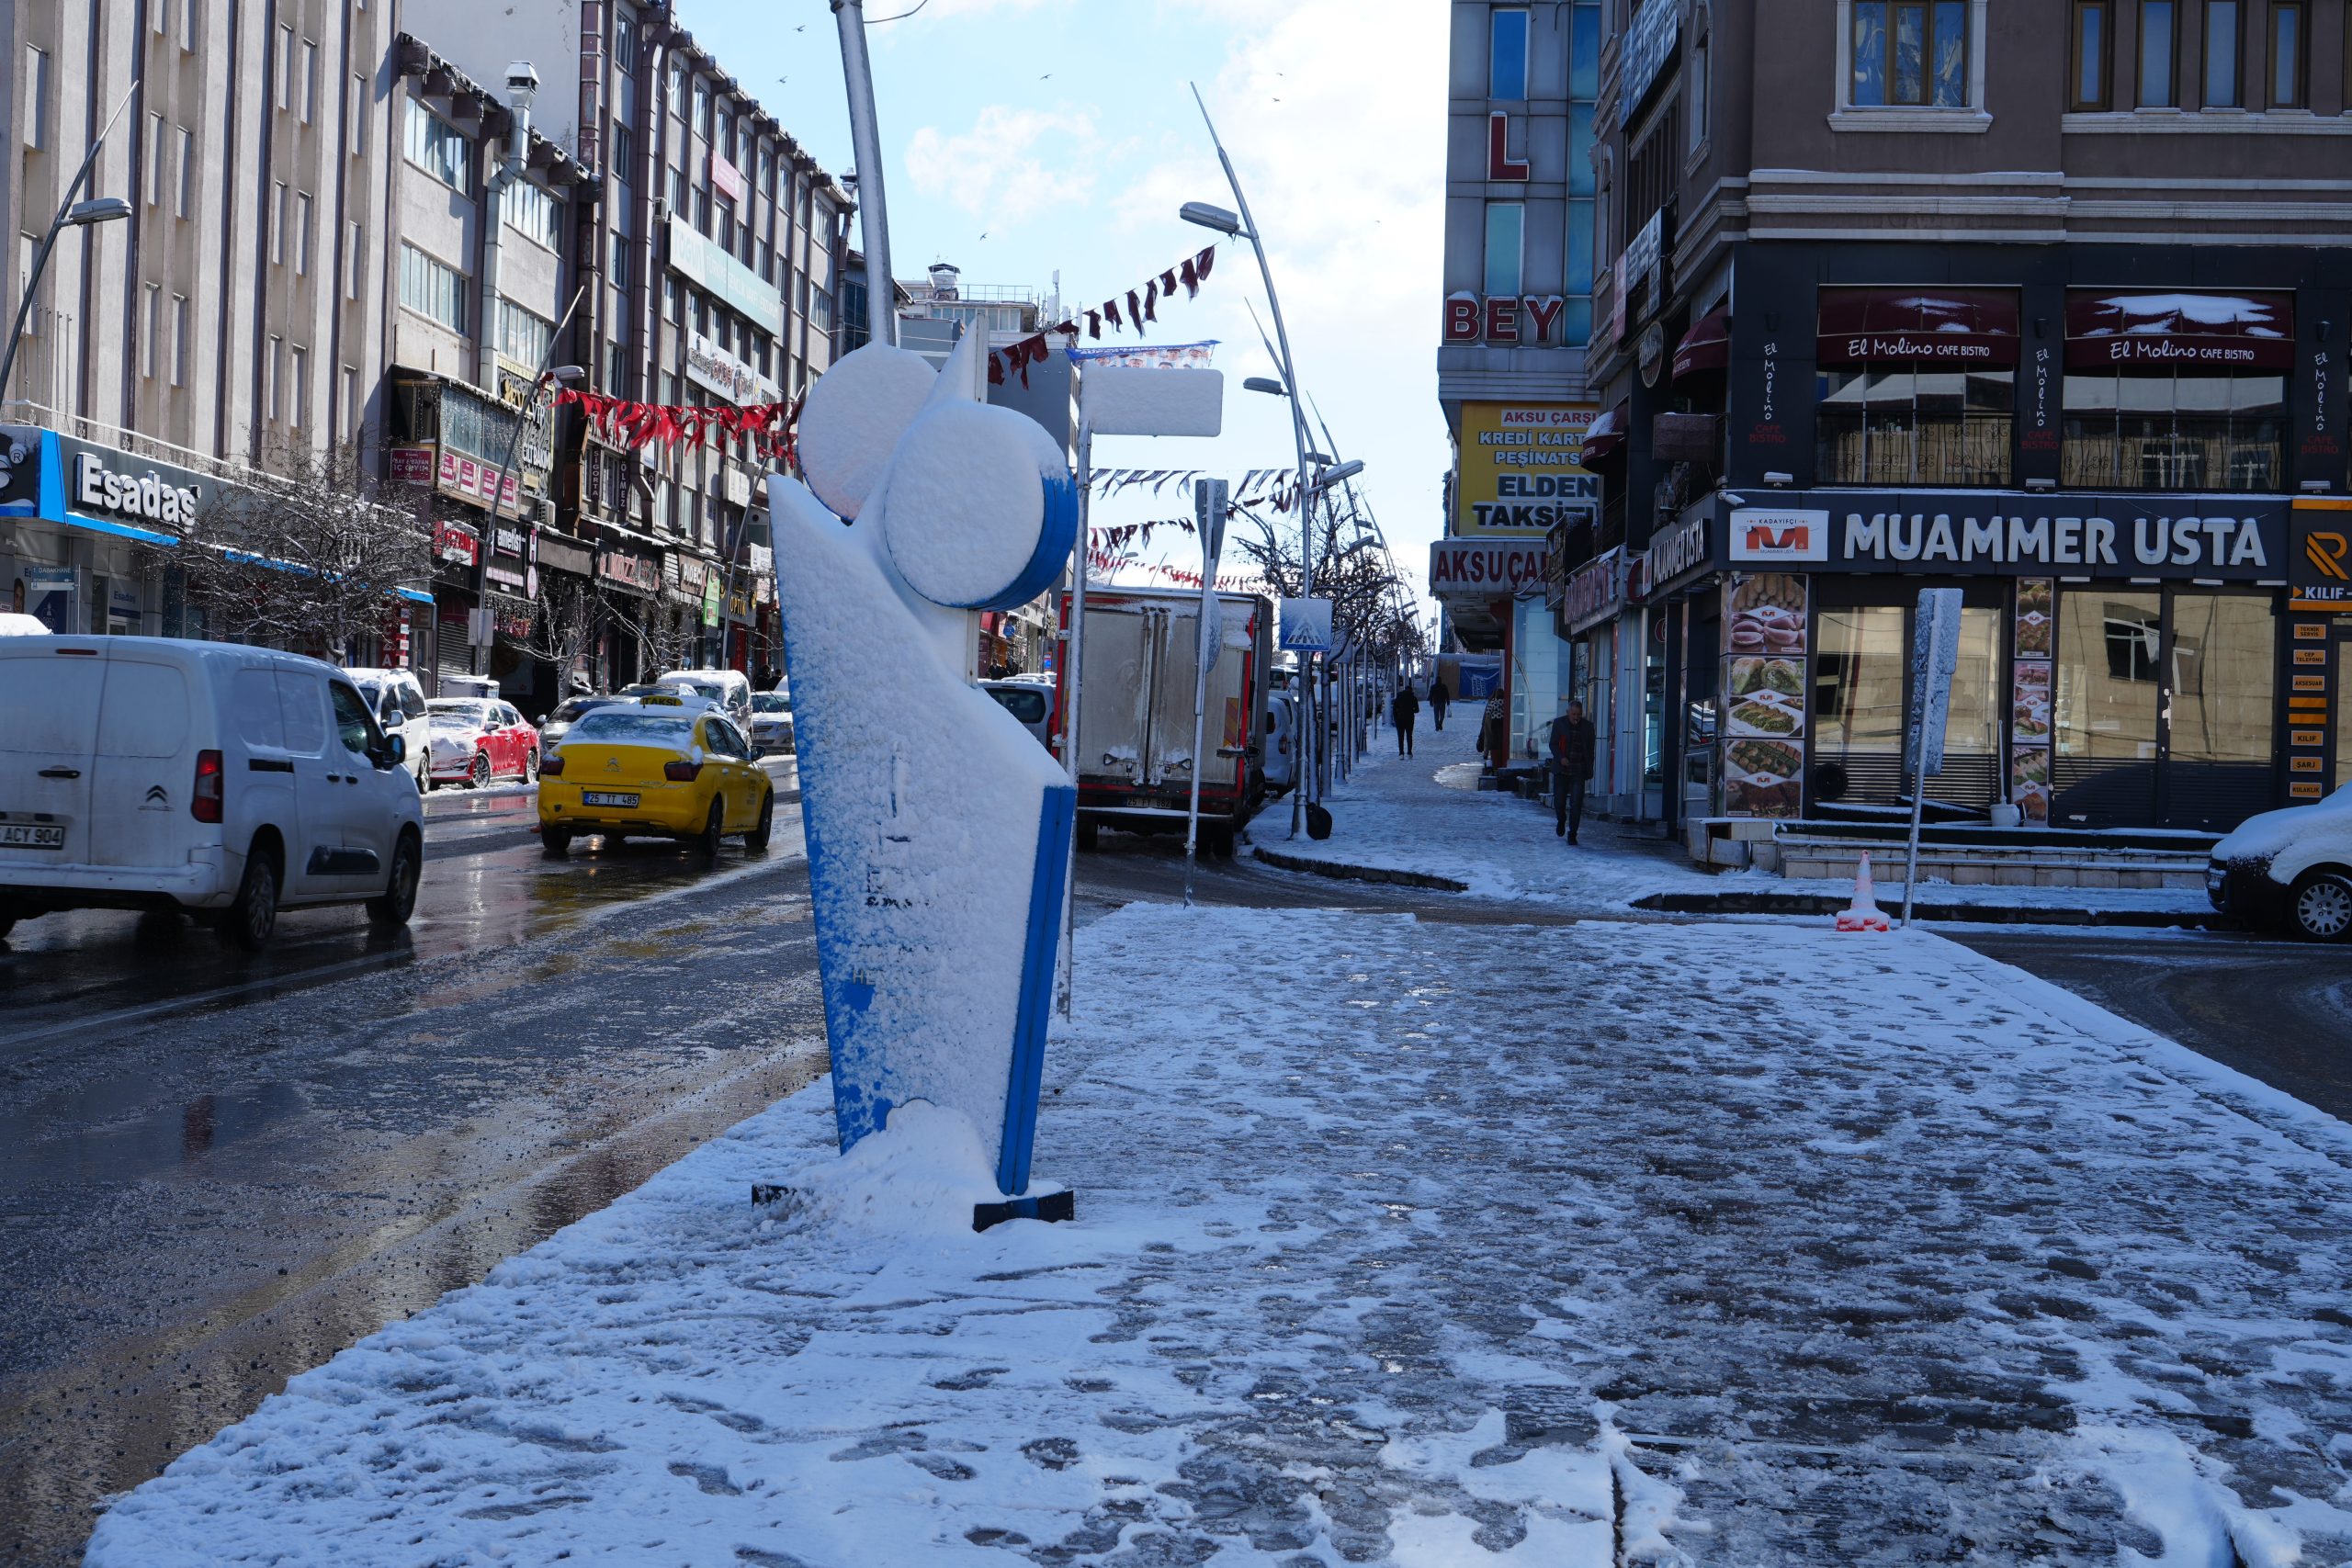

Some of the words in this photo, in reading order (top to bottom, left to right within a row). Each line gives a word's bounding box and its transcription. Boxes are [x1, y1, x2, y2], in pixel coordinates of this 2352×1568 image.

[1444, 297, 1563, 342] BEY
[1764, 343, 1777, 356] El
[1849, 339, 1868, 357] El
[1873, 337, 1933, 355] Molino
[1937, 344, 1959, 355] CAFE
[1962, 345, 1990, 357] BISTRO
[2110, 340, 2131, 359] El
[2136, 340, 2197, 358] Molino
[2200, 348, 2222, 359] CAFE
[2225, 349, 2255, 360] BISTRO
[2036, 348, 2049, 362] El
[2315, 352, 2328, 366] El
[1763, 359, 1776, 421] Molino
[2036, 366, 2048, 427] Molino
[2314, 370, 2326, 431] Molino
[1503, 412, 1545, 423] AKSU
[1755, 424, 1781, 434] CAFE
[2028, 431, 2054, 441] CAFE
[1479, 429, 1532, 446] KREDİ
[1749, 434, 1786, 444] BISTRO
[2021, 440, 2059, 450] BISTRO
[2307, 435, 2334, 446] CAFE
[2301, 445, 2338, 455] BISTRO
[1494, 448, 1582, 468] PEŞİNATS
[1498, 474, 1600, 498] ELDEN
[1843, 513, 2119, 564] MUAMMER
[2133, 516, 2267, 566] USTA
[1654, 529, 1686, 588] MUAMMER
[1686, 518, 1704, 569] USTA
[1435, 551, 1503, 582] AKSU
[2305, 586, 2345, 600] KILIF
[588, 794, 599, 804] 25
[606, 794, 616, 804] TT
[622, 795, 638, 806] 485
[4, 828, 30, 842] ACY
[35, 829, 61, 843] 904
